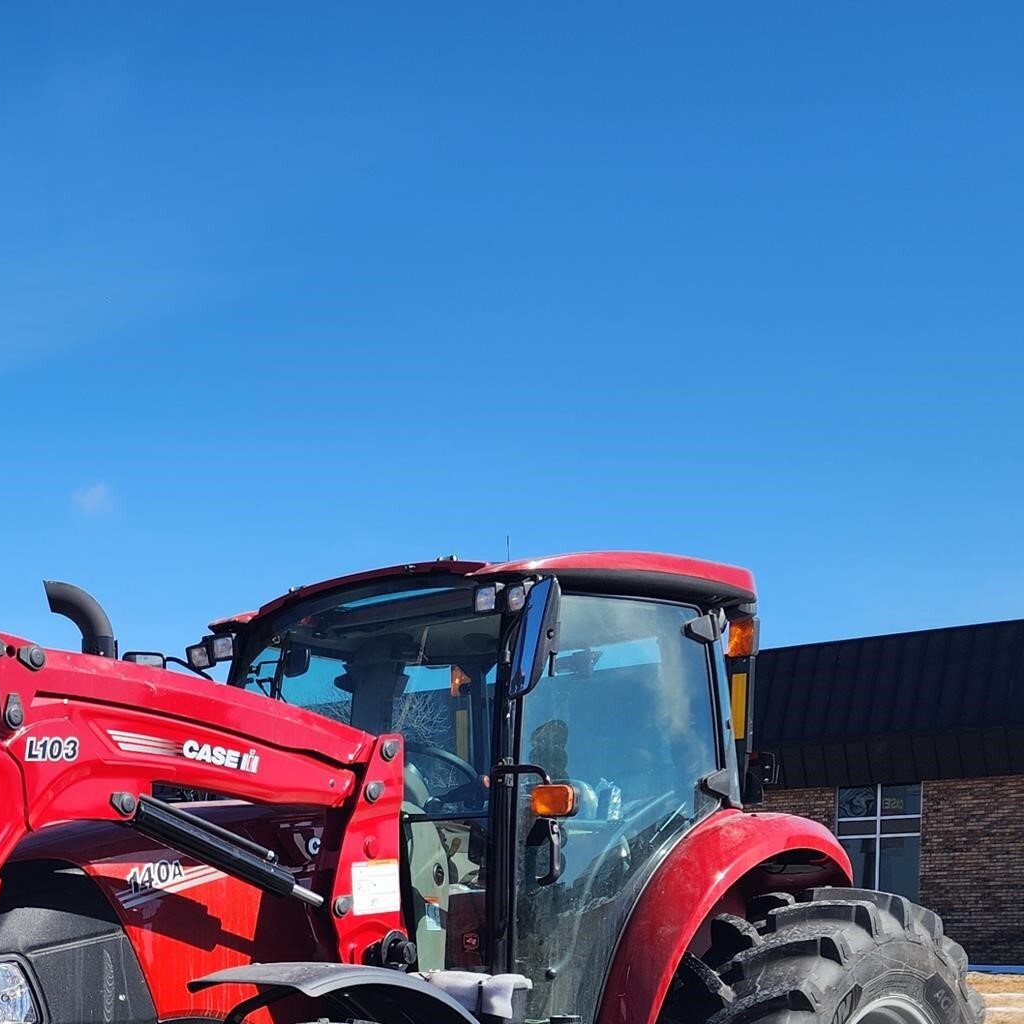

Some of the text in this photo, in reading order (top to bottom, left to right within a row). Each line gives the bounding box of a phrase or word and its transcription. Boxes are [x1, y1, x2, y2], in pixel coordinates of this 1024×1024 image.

[25, 737, 79, 762] L103
[182, 740, 240, 770] CASE
[128, 859, 185, 895] 140A
